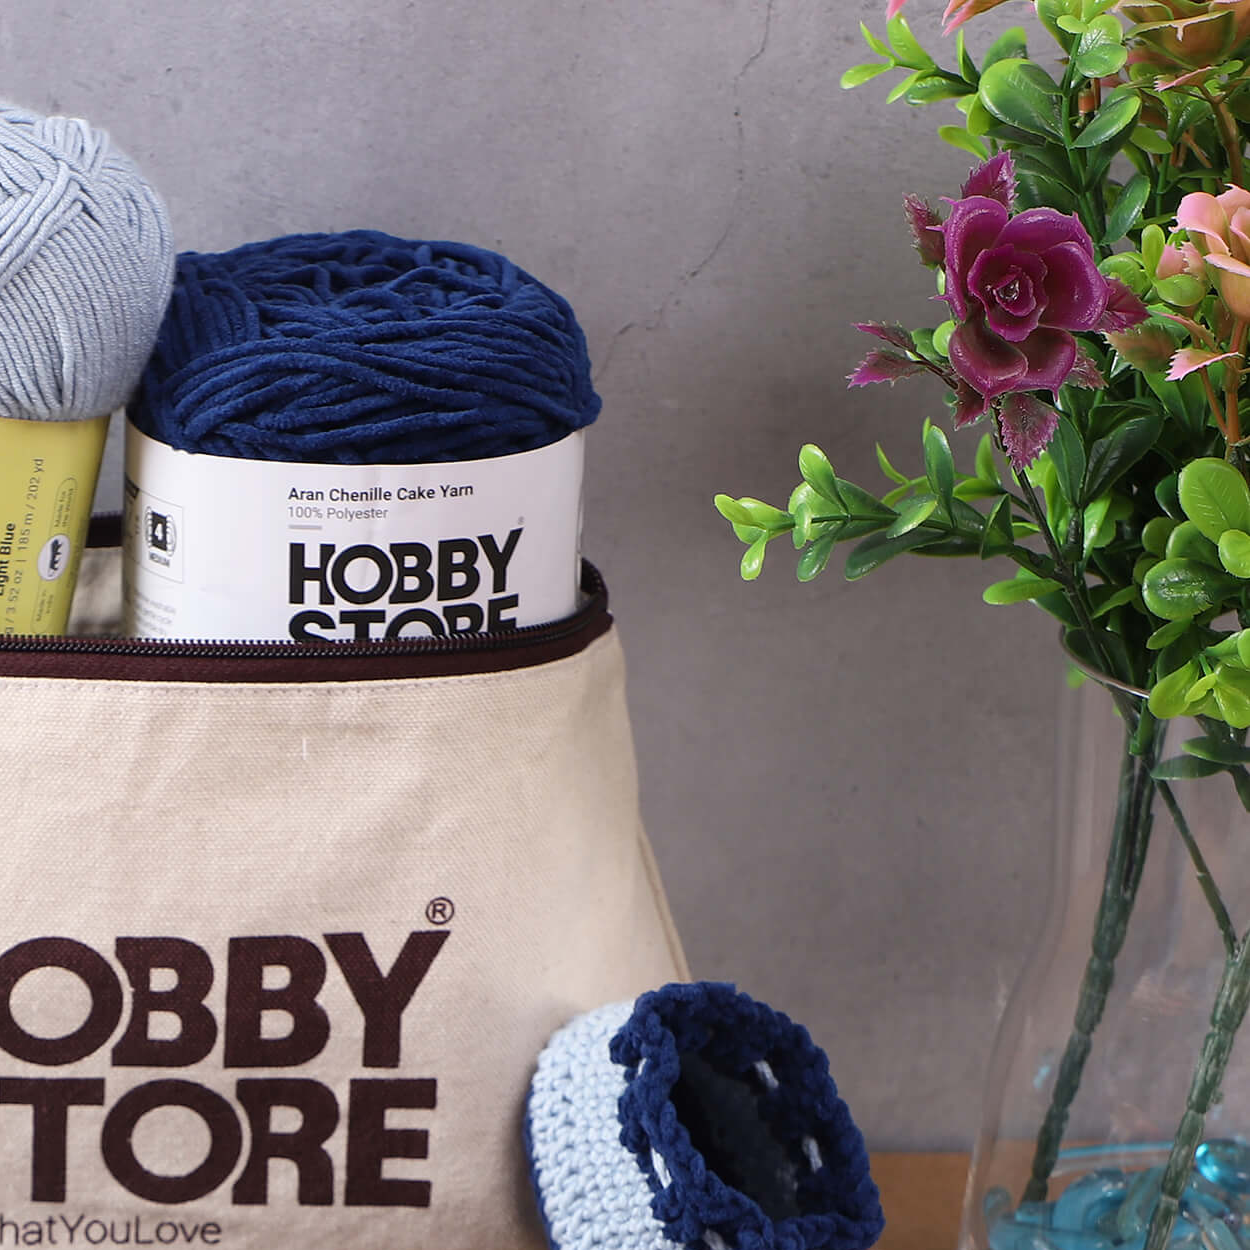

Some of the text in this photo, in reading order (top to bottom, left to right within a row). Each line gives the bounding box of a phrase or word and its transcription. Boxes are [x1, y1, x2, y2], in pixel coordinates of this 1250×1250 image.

[18, 527, 31, 551] 185
[26, 476, 40, 501] 202
[33, 458, 45, 474] yd
[288, 484, 474, 502] Aran Chenille Cake Yarn
[288, 506, 389, 523] 100% Polyester
[0, 522, 16, 556] Blue
[154, 523, 164, 541] 4
[289, 527, 524, 605] HOBBY
